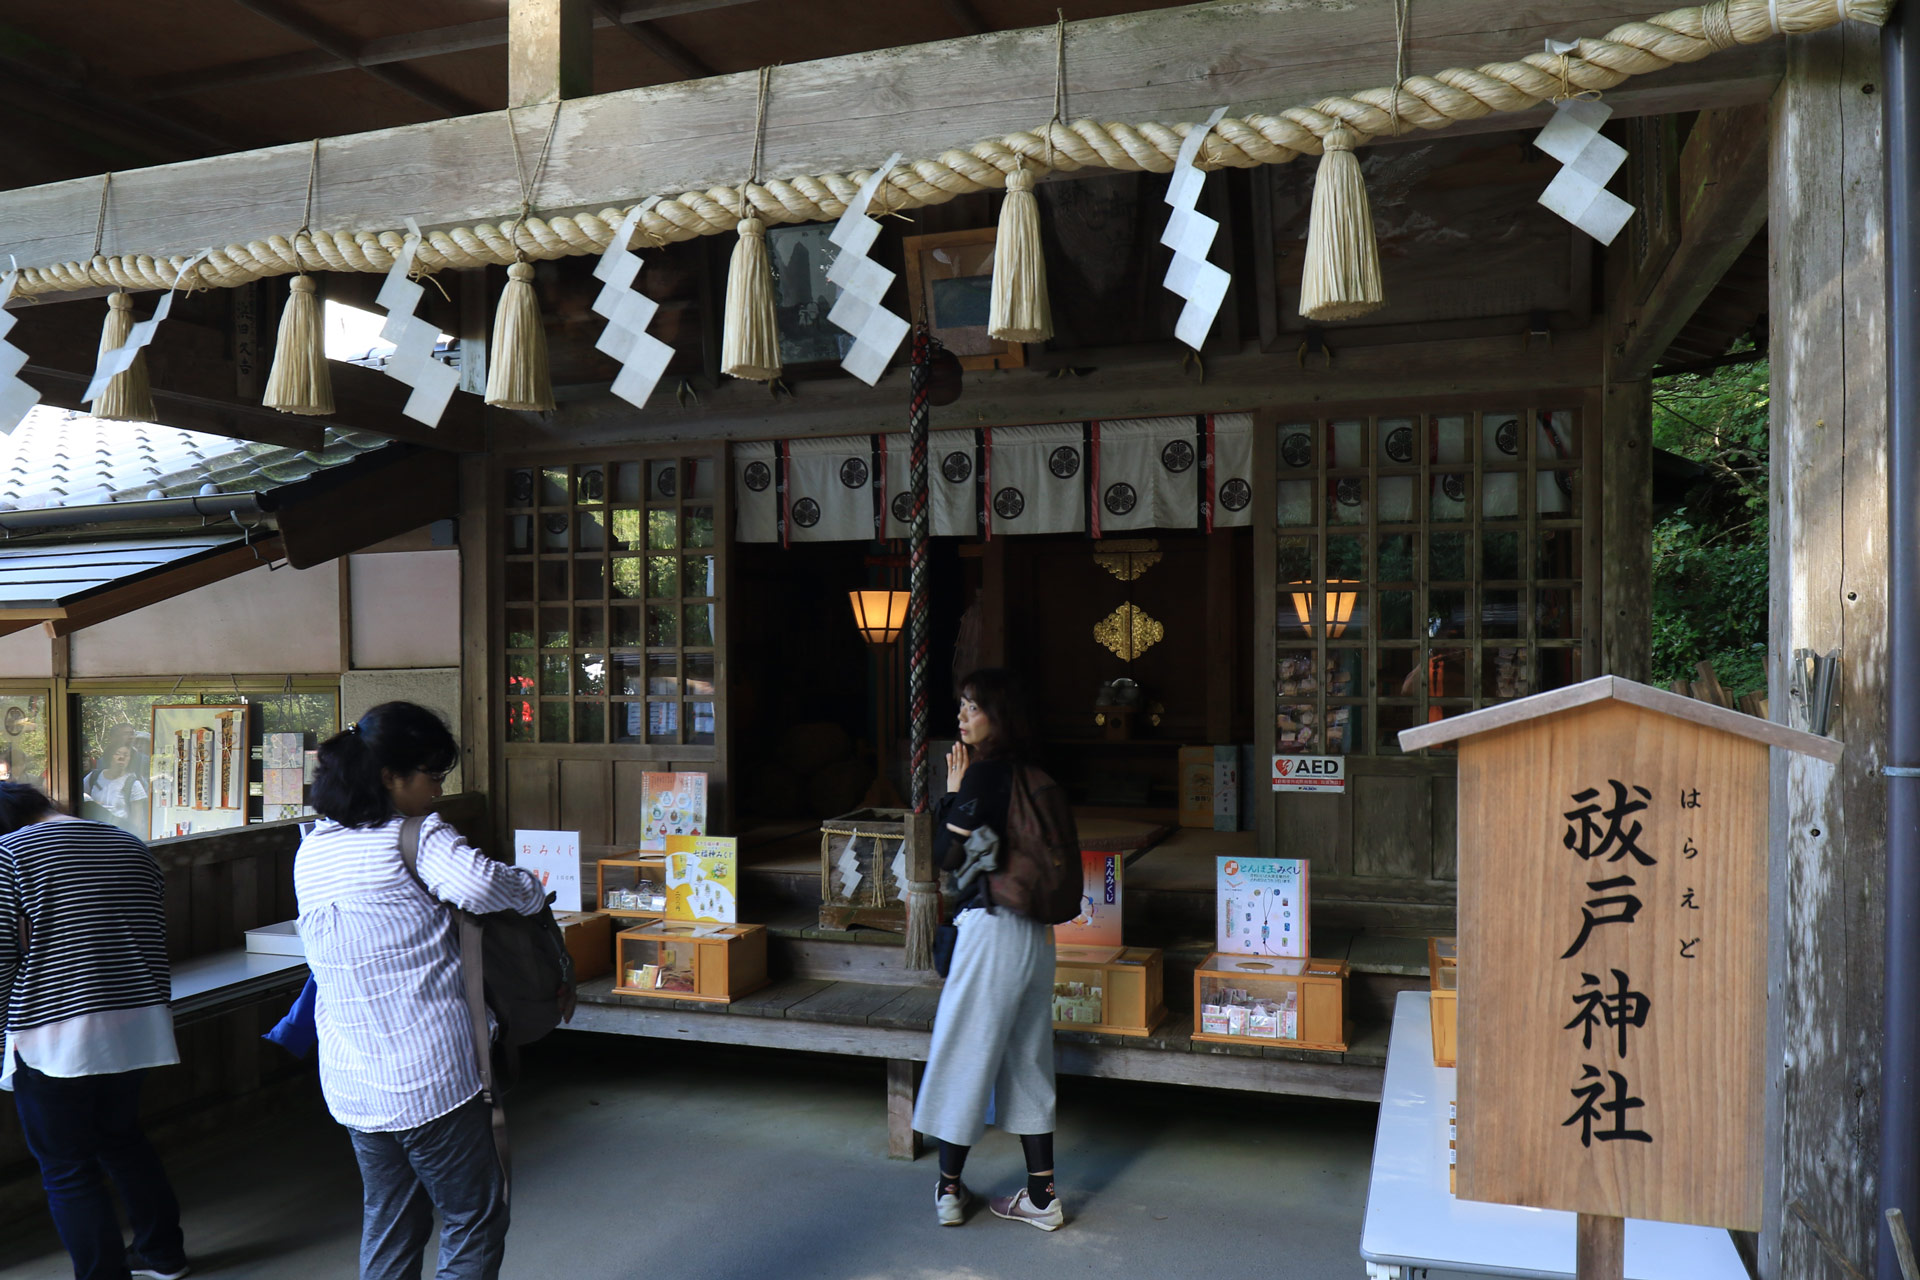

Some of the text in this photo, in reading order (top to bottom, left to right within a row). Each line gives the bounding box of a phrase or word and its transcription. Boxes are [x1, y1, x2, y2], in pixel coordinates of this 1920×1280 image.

[1295, 759, 1339, 774] AED
[522, 844, 575, 857] おみくじ
[693, 849, 733, 859] 七福神みくじ
[1105, 858, 1115, 903] えんみくじ
[1680, 788, 1701, 959] はらえど
[1559, 779, 1657, 1148] 祓戸神社
